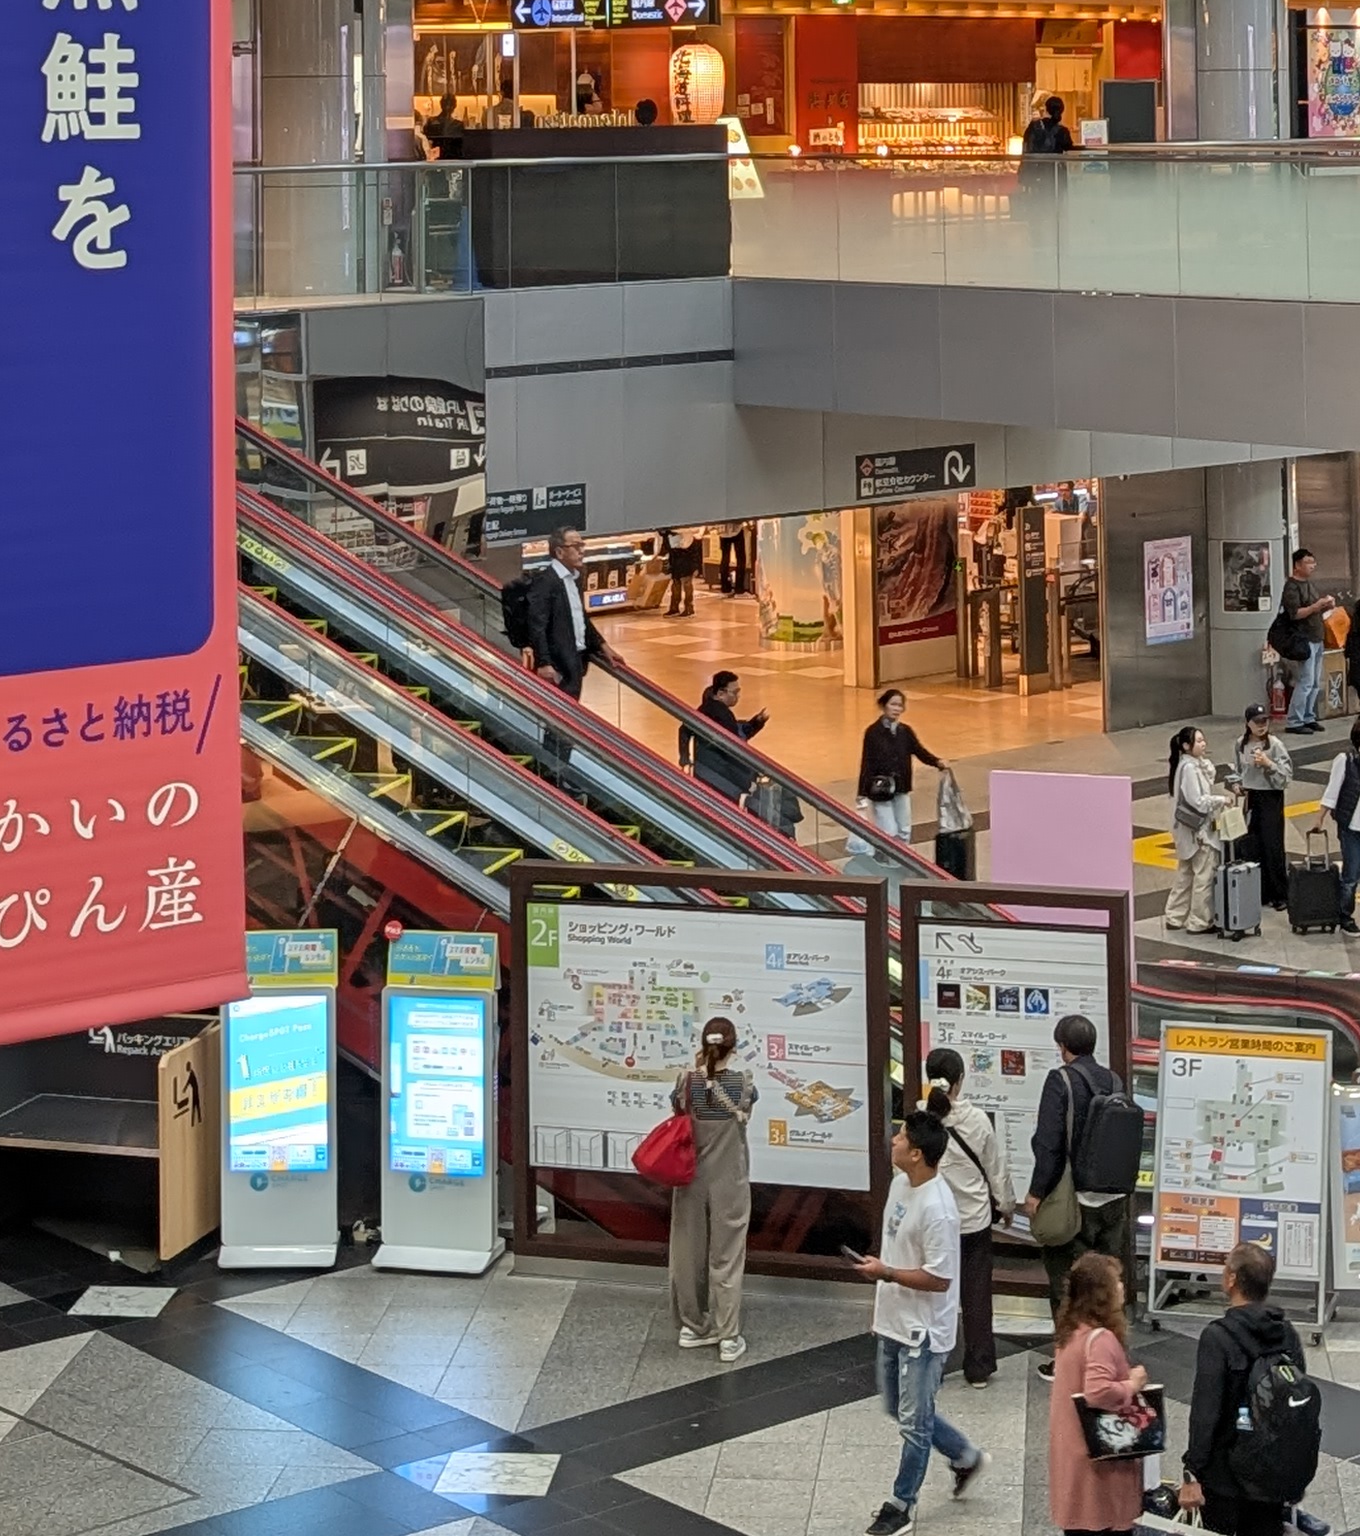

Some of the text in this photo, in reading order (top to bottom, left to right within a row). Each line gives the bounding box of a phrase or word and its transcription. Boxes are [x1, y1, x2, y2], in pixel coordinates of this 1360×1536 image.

[530, 920, 558, 948] 2F
[117, 1044, 149, 1056] Repack
[1175, 1034, 1316, 1056] レストラン営業時間のご案内
[1171, 1057, 1202, 1078] 3F
